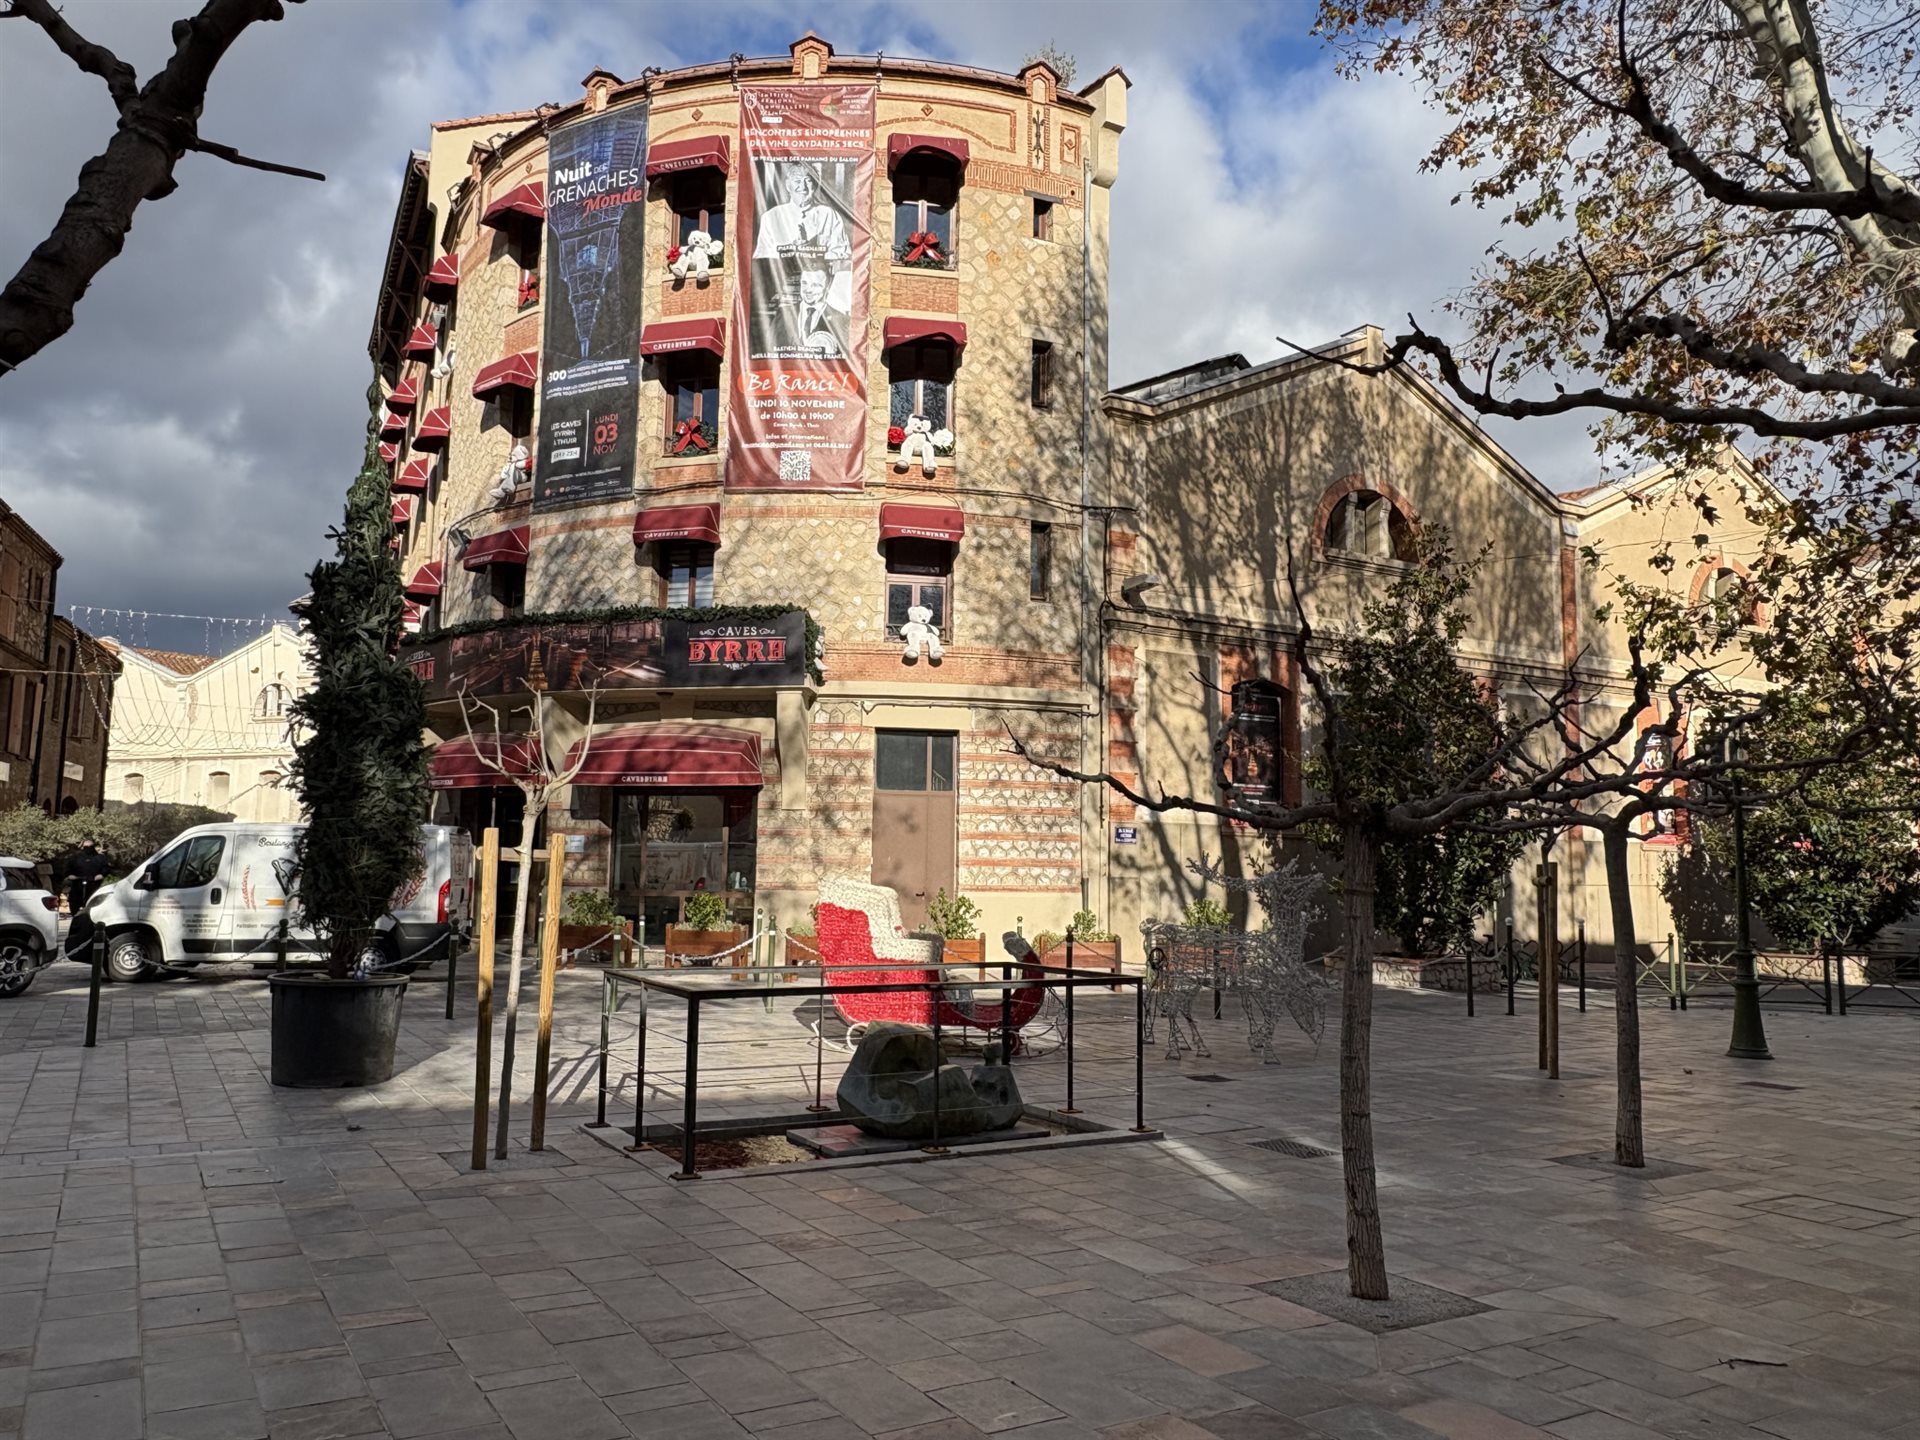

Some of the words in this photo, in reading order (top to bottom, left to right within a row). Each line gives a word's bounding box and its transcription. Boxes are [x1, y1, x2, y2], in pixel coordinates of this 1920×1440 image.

[744, 128, 802, 136] RENCONTRES
[791, 140, 840, 148] OXYDATIFS
[842, 140, 864, 148] SECS
[555, 161, 592, 185] Nuit
[548, 168, 639, 207] GRENACHES
[582, 186, 642, 217] Monde
[747, 373, 772, 391] Be
[775, 373, 835, 393] Ranci
[748, 399, 777, 408] LUNDI
[779, 400, 789, 408] 10
[791, 400, 845, 409] NOVEMBRE
[594, 413, 618, 424] LUNDI
[760, 412, 771, 420] de
[773, 412, 798, 420] 10h00
[810, 412, 835, 420] 19h00
[560, 420, 582, 429] CAVES
[594, 423, 618, 444] 03
[593, 444, 617, 455] NOV.
[717, 626, 757, 636] CAVES
[688, 640, 786, 662] BYRRH
